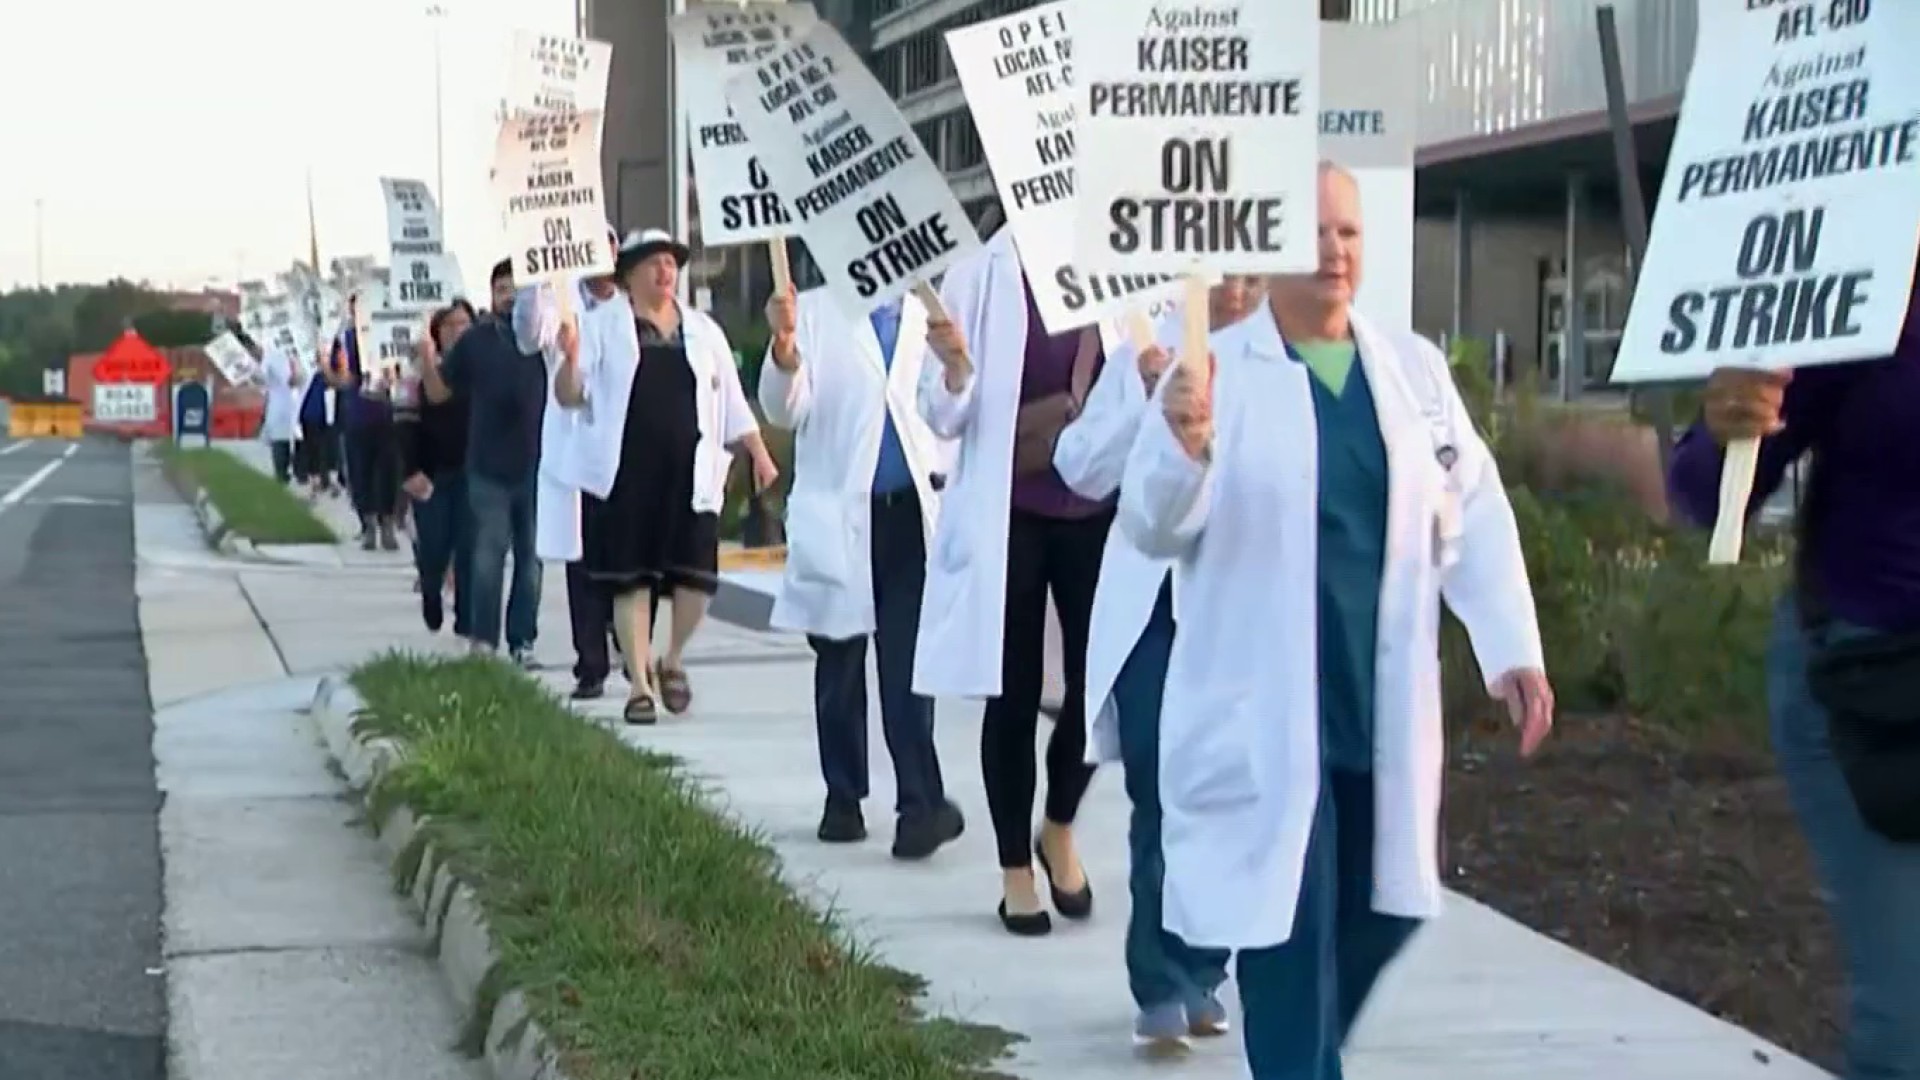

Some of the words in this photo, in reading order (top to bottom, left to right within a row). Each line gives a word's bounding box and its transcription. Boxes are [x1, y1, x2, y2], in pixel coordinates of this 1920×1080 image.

[1145, 7, 1238, 34] Against
[1774, 0, 1871, 43] AFL-CIO
[993, 45, 1053, 80] LOCAL
[1137, 36, 1249, 72] KAISER
[1763, 46, 1866, 88] Against
[1089, 80, 1301, 116] PERMANENTE
[1743, 78, 1871, 144] KAISER
[805, 124, 873, 178] KAISER
[1161, 137, 1229, 194] ON
[1679, 119, 1919, 201] PERMANENTE
[794, 136, 915, 223] PERMANENTE
[543, 216, 573, 243] ON
[855, 191, 908, 245] ON
[1109, 198, 1283, 254] STRIKE
[1736, 205, 1824, 279] ON
[526, 239, 596, 275] STRIKE
[847, 211, 959, 298] STRIKE
[1660, 268, 1873, 354] STRIKE
